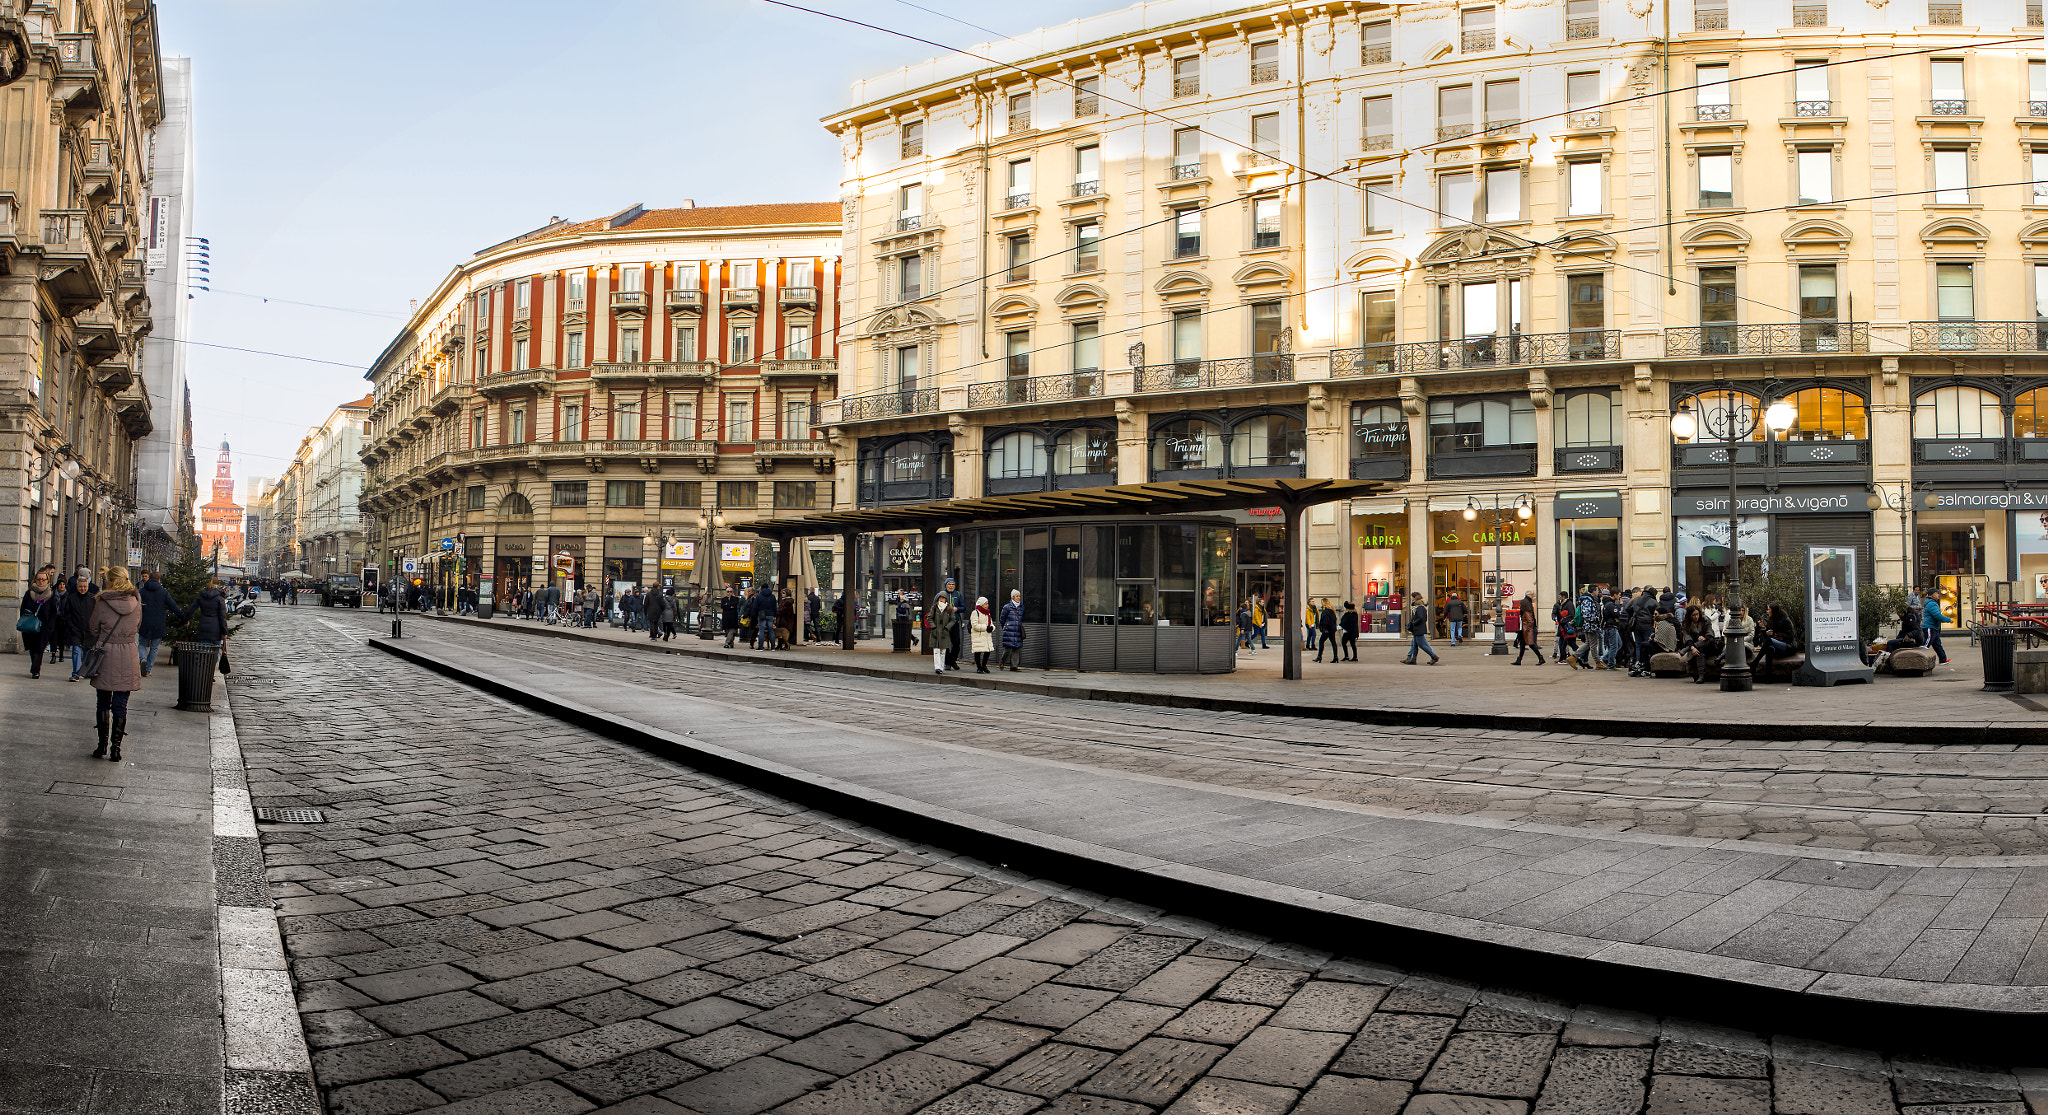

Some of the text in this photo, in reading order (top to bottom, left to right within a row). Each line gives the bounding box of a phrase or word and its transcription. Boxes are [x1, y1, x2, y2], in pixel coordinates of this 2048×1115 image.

[159, 197, 167, 249] BELLUSCHI
[1355, 424, 1408, 448] Triumph
[1065, 441, 1108, 462] Triumph
[1165, 436, 1212, 457] Triumph
[891, 454, 926, 473] Triumph
[1784, 496, 1796, 508] &
[1937, 493, 2021, 508] salmoiraghi
[2023, 492, 2035, 505] &
[1473, 531, 1520, 543] CARISA
[1700, 524, 1746, 536] SMIH
[1357, 535, 1402, 546] CARPISA
